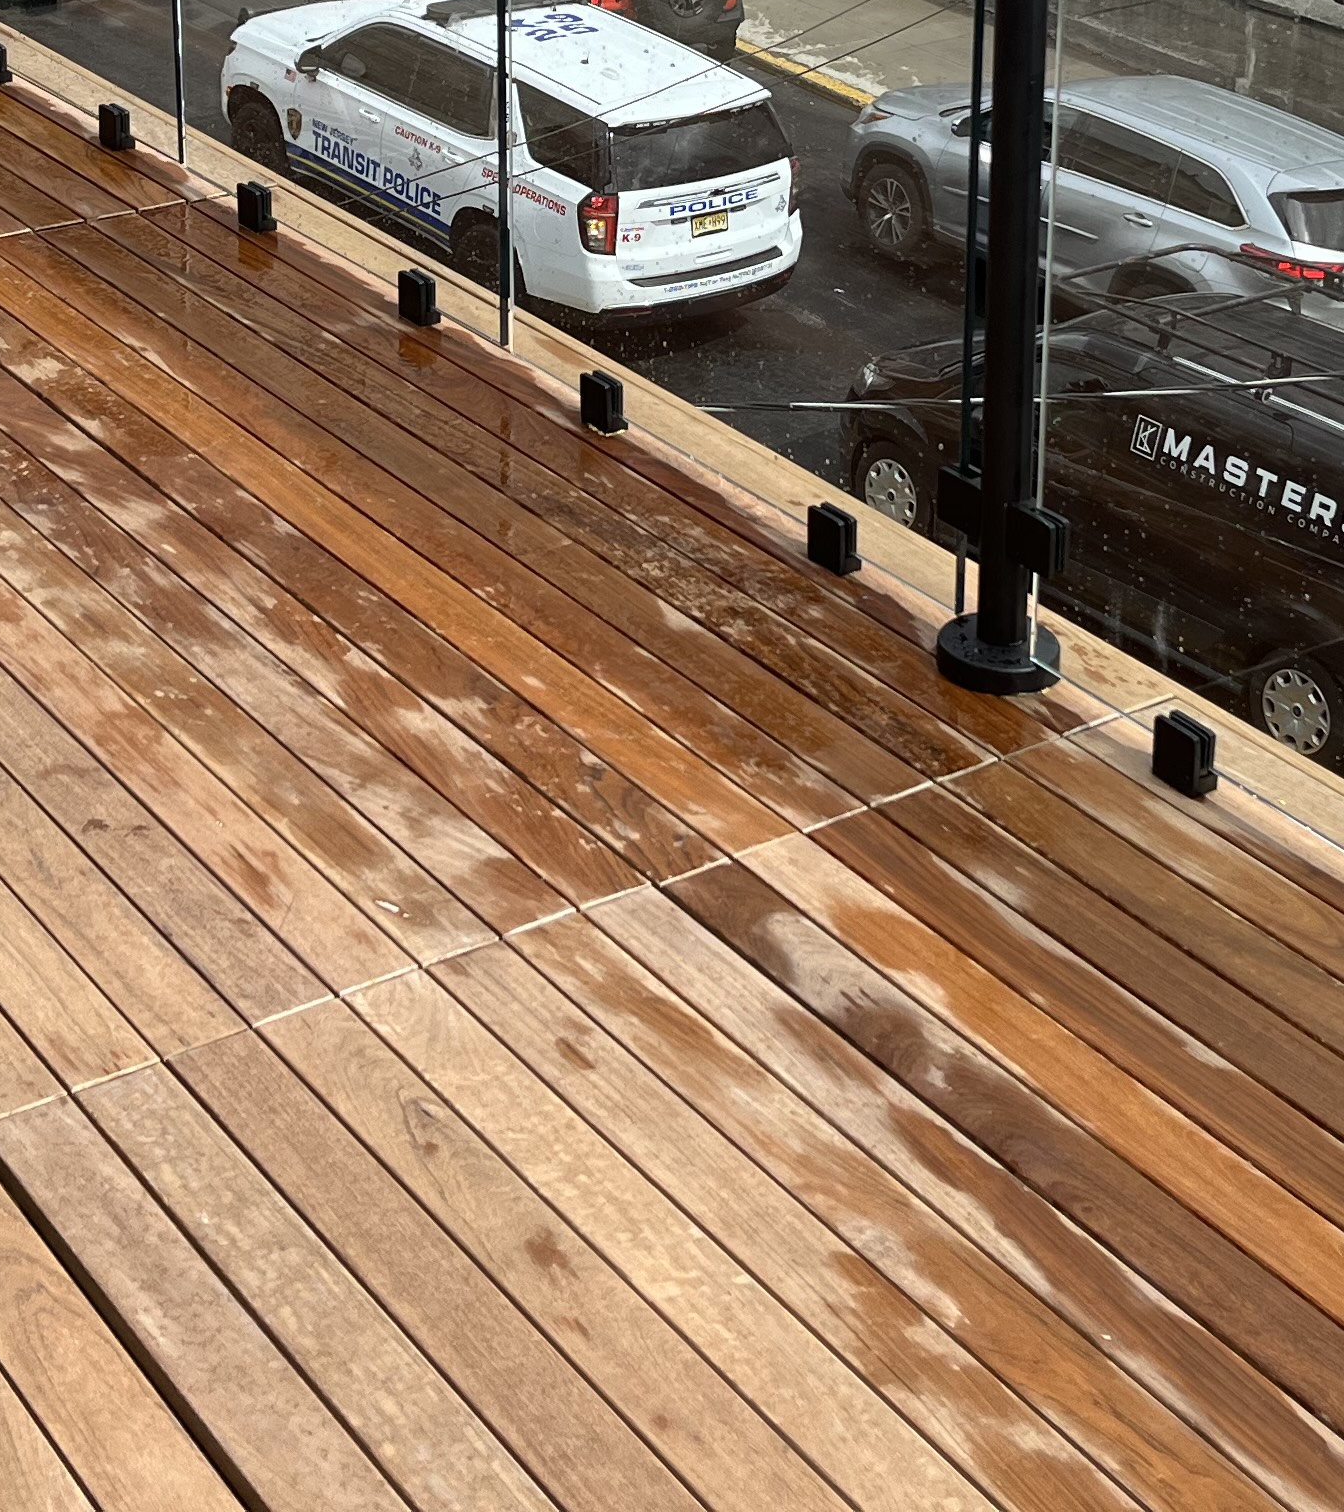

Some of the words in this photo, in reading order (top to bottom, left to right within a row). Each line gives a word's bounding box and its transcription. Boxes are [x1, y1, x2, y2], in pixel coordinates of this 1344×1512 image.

[312, 118, 328, 133] NEW
[330, 128, 356, 146] JERSEY
[395, 126, 429, 148] CAUTION
[312, 130, 381, 183] TRANSIT
[382, 166, 441, 217] POLICE
[515, 184, 567, 216] OPERATIONS
[669, 188, 759, 217] POLICE
[622, 233, 641, 243] K-9
[1159, 456, 1276, 516] CONSTRUCTION
